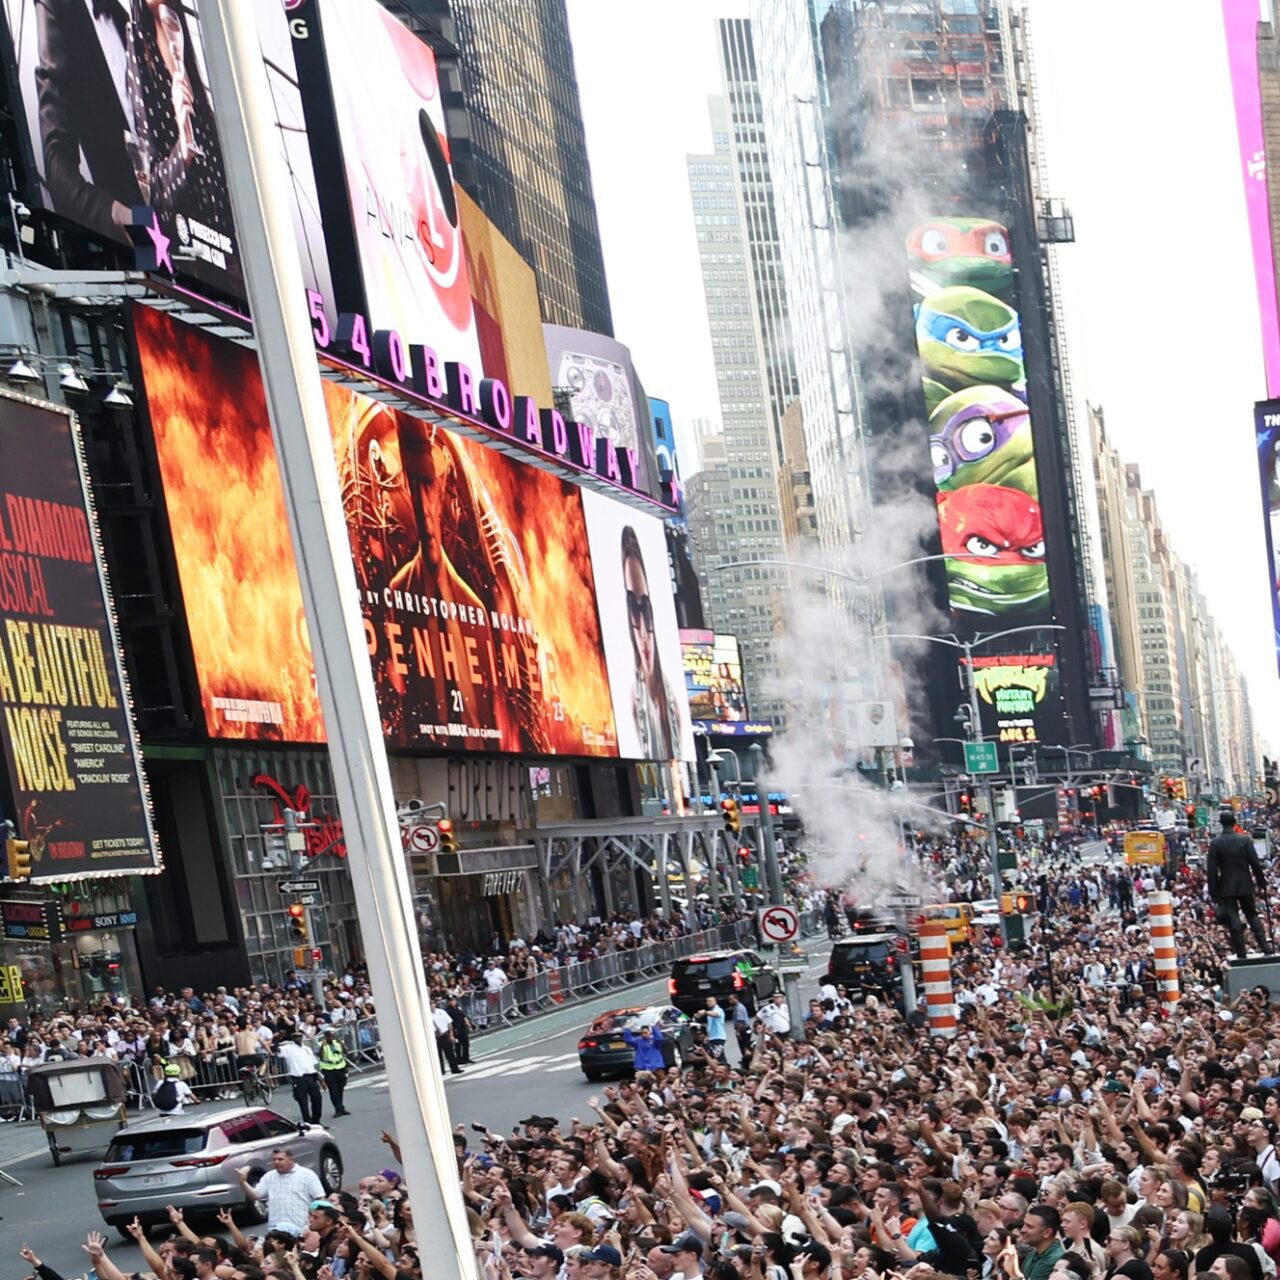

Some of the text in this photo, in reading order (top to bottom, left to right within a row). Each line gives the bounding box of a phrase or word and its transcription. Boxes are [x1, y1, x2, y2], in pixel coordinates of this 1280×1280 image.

[5, 492, 93, 564] DIAMOND
[366, 587, 534, 635] BY CHRISTOPHER NOLAN
[5, 619, 118, 708] BEAUTIFUL
[66, 720, 92, 729] FEATURING
[451, 690, 564, 722] 21 23
[4, 706, 76, 791] NOISE
[448, 761, 530, 821] FOREVER
[95, 915, 117, 927] SONY
[11, 968, 22, 999] ATM
